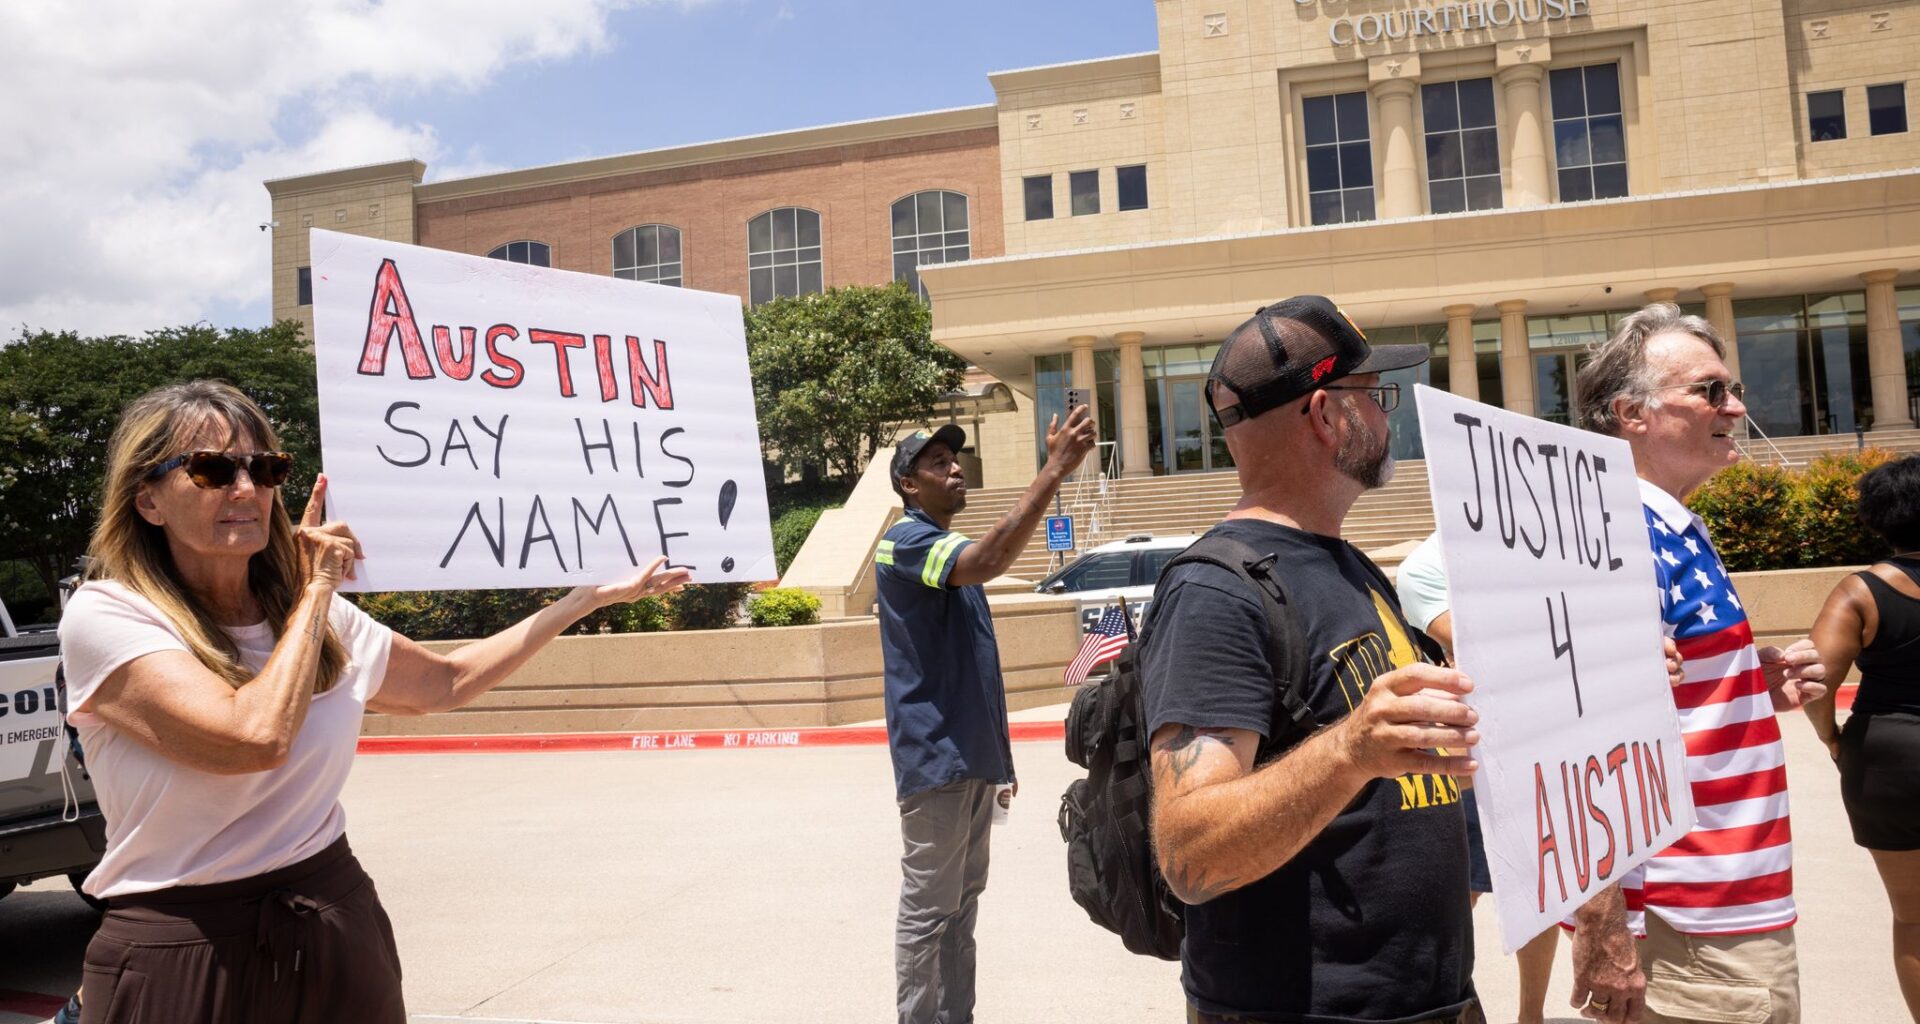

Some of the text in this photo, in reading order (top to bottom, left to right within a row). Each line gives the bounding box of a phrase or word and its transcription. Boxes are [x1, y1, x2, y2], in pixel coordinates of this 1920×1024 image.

[1328, 0, 1592, 46] COURTHOUSE
[357, 258, 675, 410] AUSTIN
[376, 401, 695, 487] SAY HIS
[1454, 413, 1624, 571] JUSTICE
[1545, 591, 1584, 718] 4
[632, 731, 799, 748] FIRE LANE NO PARKING
[1534, 739, 1673, 913] AUSTIN
